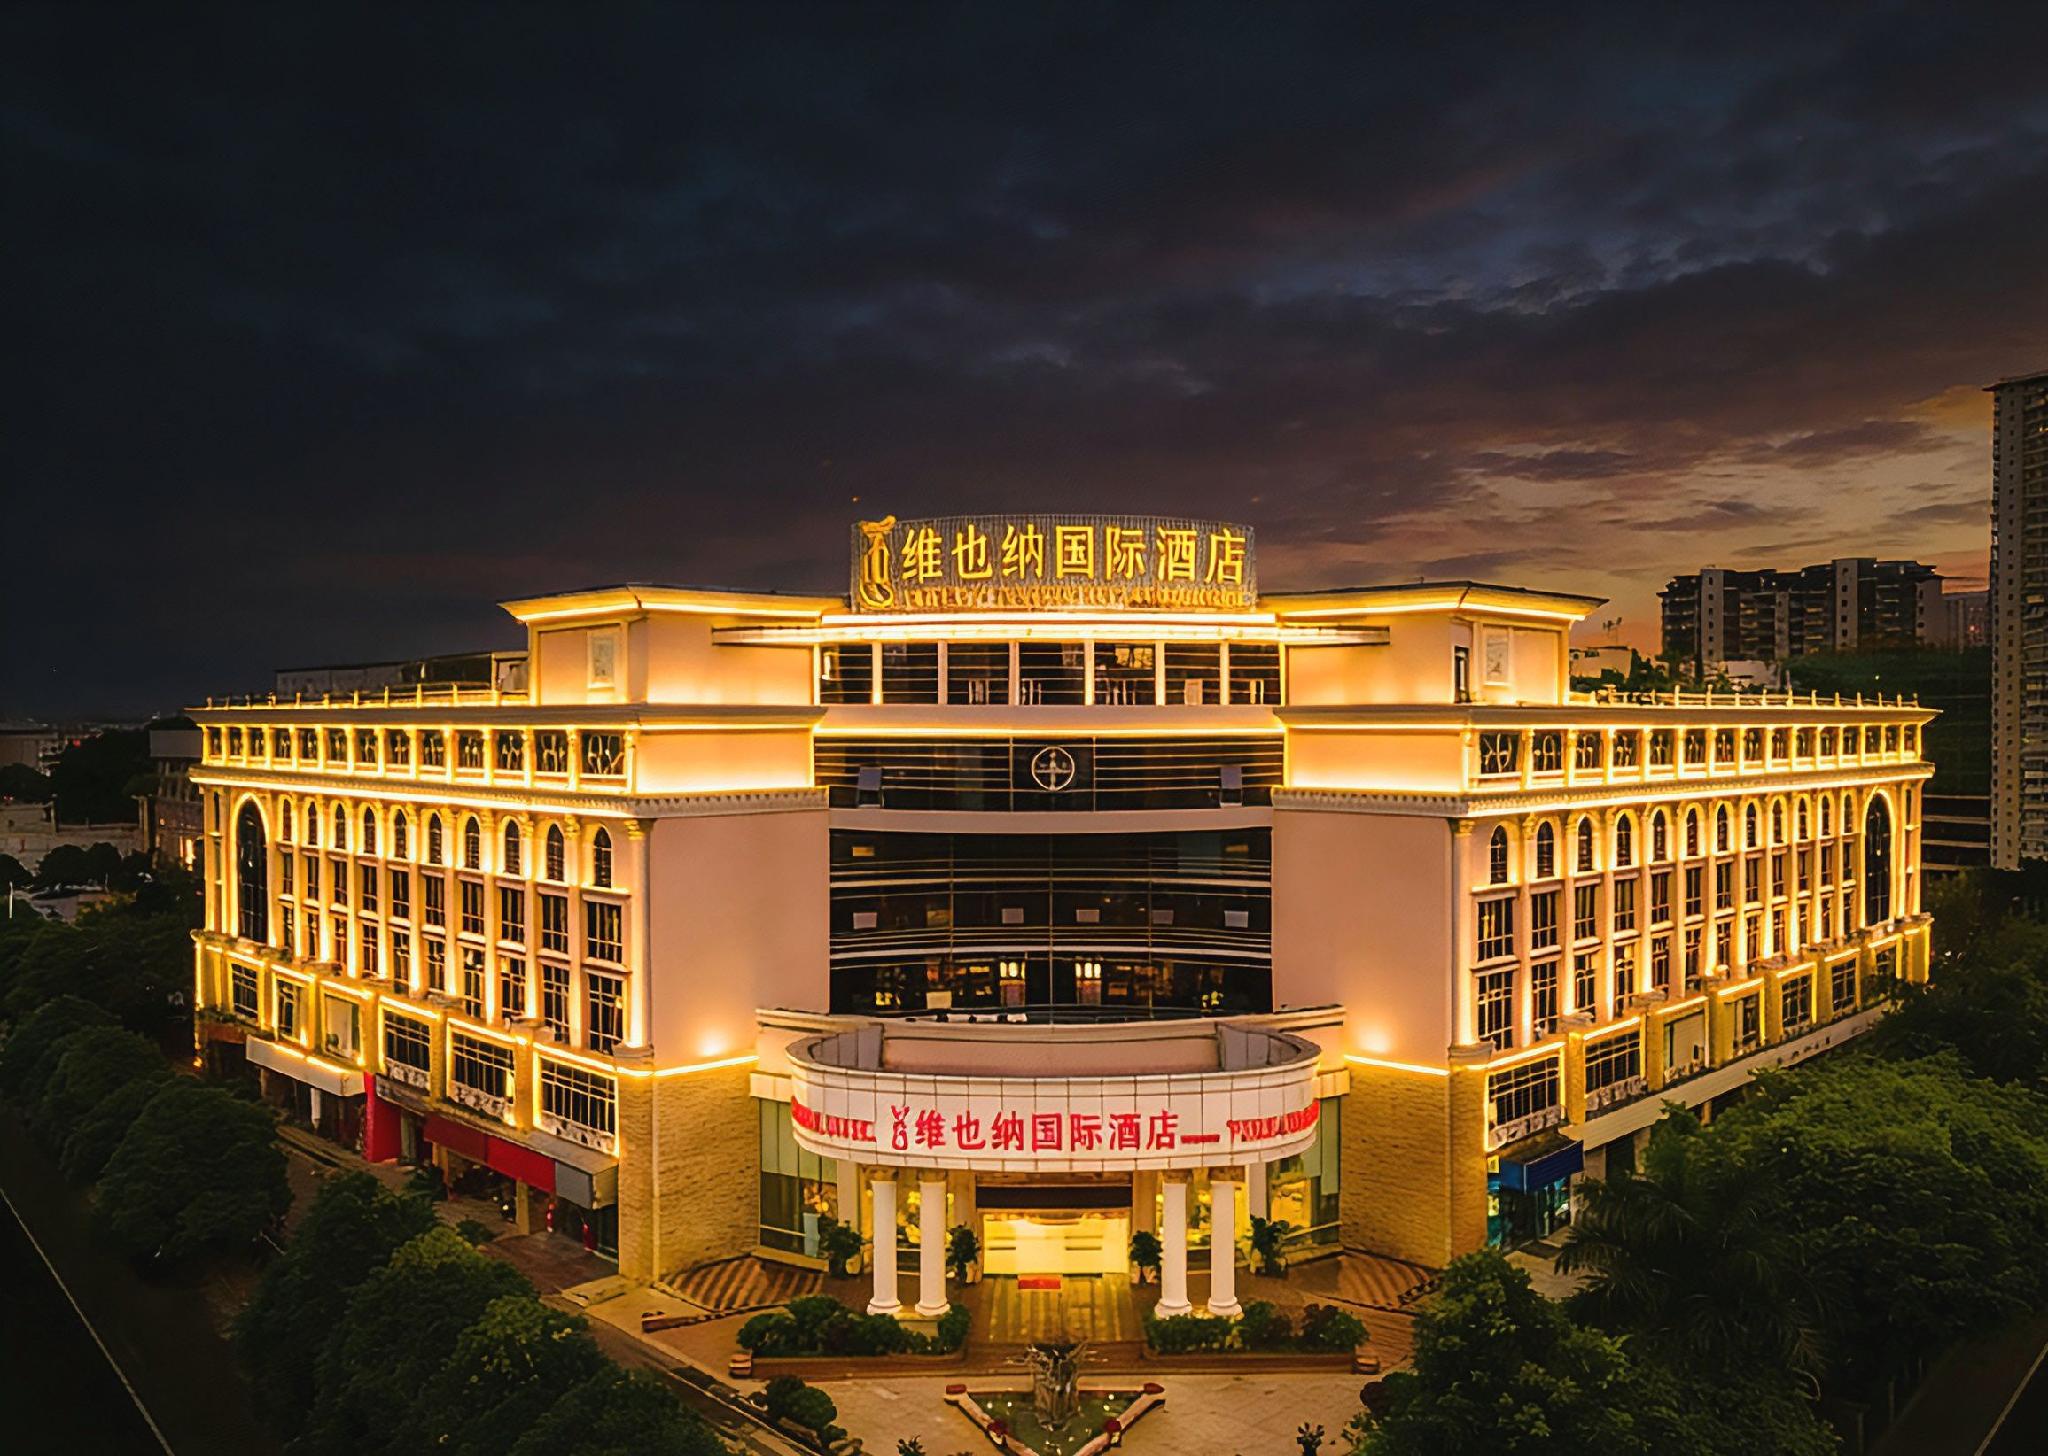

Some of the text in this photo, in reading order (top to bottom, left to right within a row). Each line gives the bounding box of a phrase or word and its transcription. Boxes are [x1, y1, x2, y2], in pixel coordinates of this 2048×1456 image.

[902, 524, 1246, 583] 维也纳国际酒店
[915, 1109, 1178, 1151] 维也纳国际酒店
